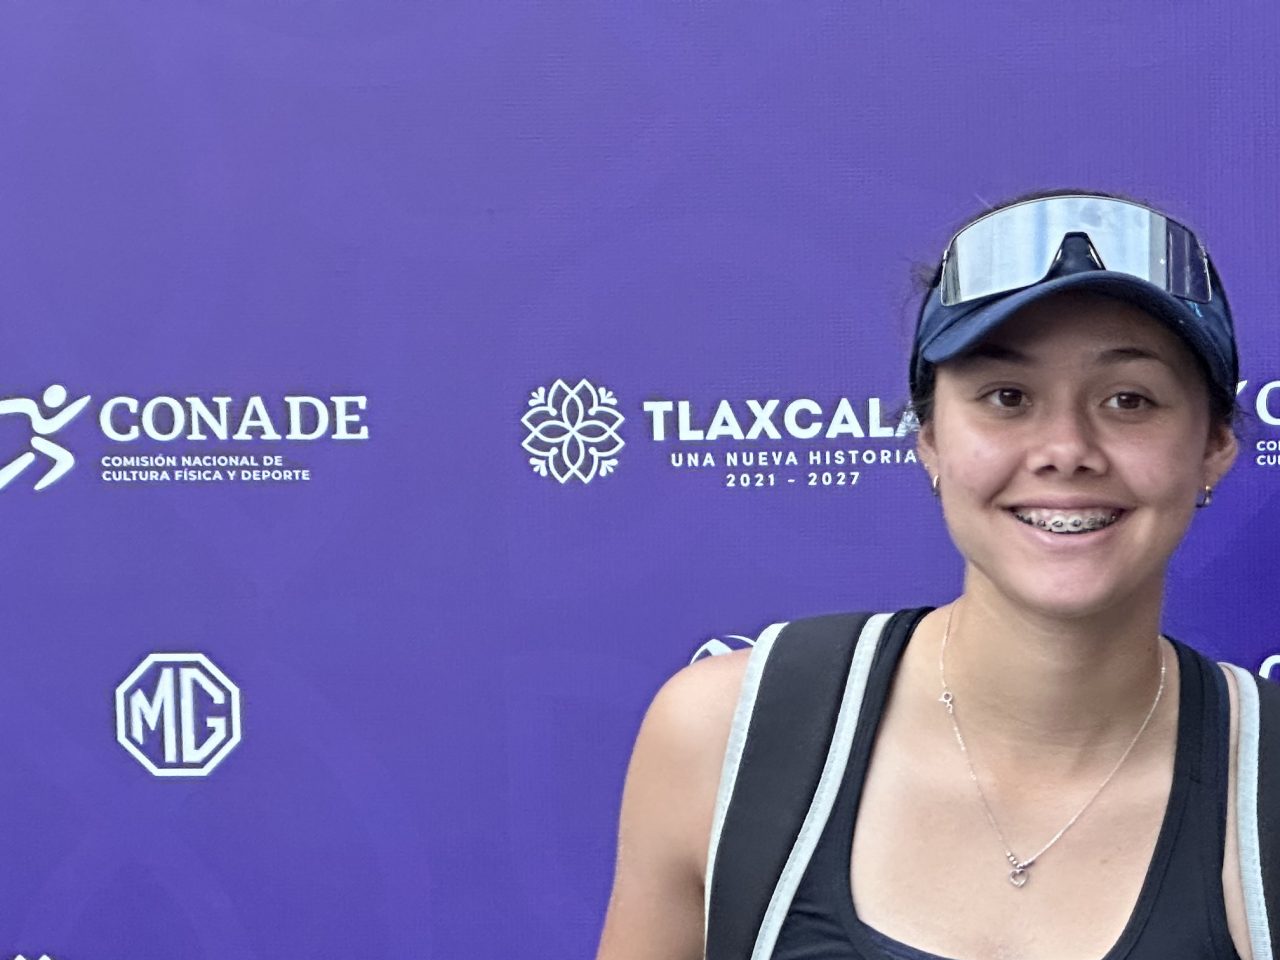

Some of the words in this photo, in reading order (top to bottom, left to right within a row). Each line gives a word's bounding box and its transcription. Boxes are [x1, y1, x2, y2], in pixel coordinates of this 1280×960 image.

[100, 395, 369, 442] CONADE
[101, 454, 177, 467] COMISIÓN
[181, 455, 258, 467] NACIONAL
[262, 455, 284, 466] DE
[671, 452, 716, 468] UNA
[726, 451, 798, 467] NUEVA
[809, 448, 917, 465] HISTORIA
[101, 470, 170, 481] CULTURA
[174, 468, 223, 481] FÍSICA
[227, 470, 236, 481] Y
[241, 469, 310, 481] DEPORTE
[726, 473, 776, 488] 2021
[808, 471, 861, 487] 2027
[131, 666, 226, 764] MG
